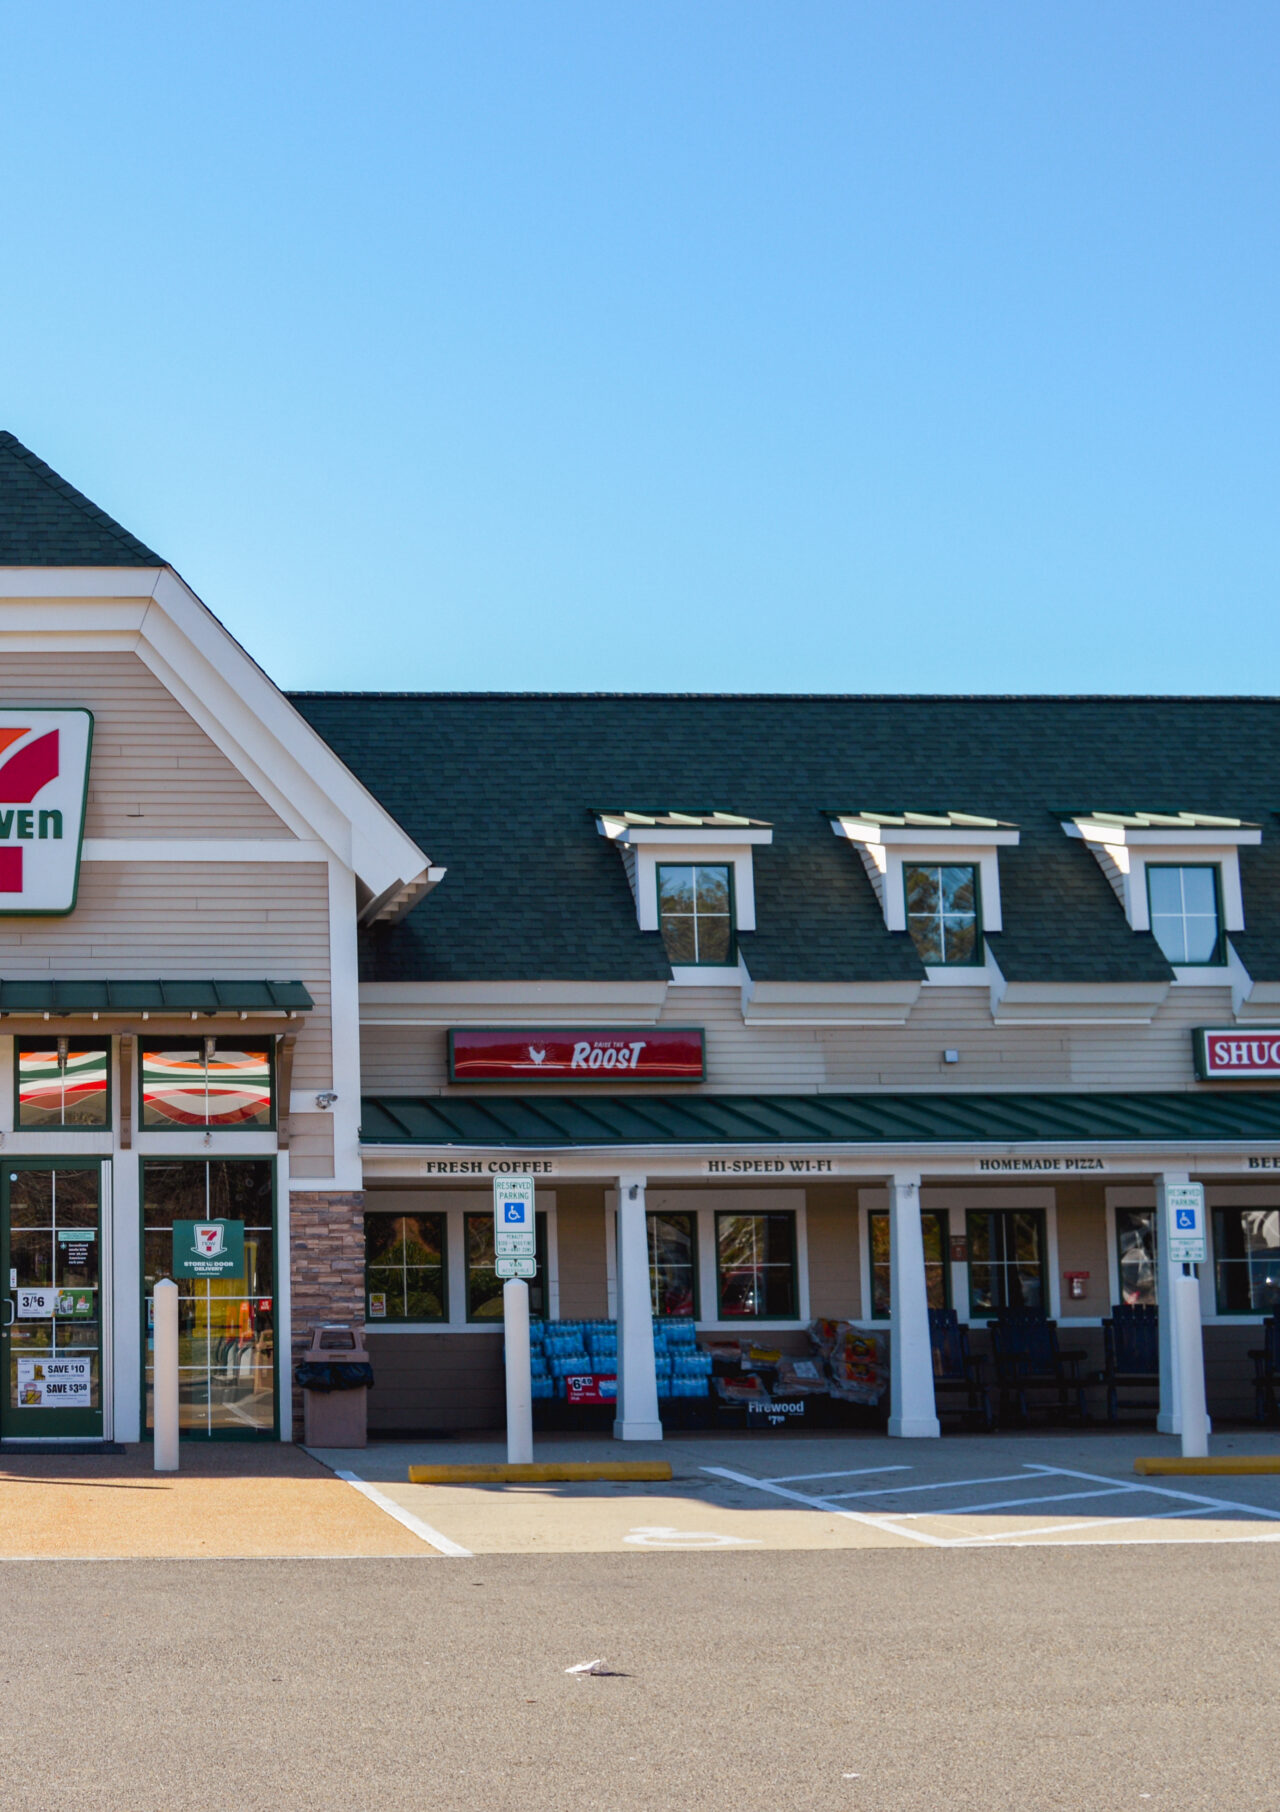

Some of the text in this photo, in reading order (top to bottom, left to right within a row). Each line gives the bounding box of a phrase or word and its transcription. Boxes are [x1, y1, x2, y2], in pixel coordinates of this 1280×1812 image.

[570, 1041, 647, 1069] ROOST
[426, 1161, 553, 1173] FRESH COFFEE
[708, 1160, 832, 1172] HI-SPEED WI-FI
[980, 1159, 1105, 1170] HOMEMADE PIZZA
[497, 1182, 531, 1190] RESERVED
[500, 1192, 529, 1200] PARKING
[22, 1296, 45, 1308] 3/$6
[48, 1365, 85, 1373] SAVE $10
[46, 1384, 68, 1393] SAVE
[748, 1400, 805, 1413] Firewood
